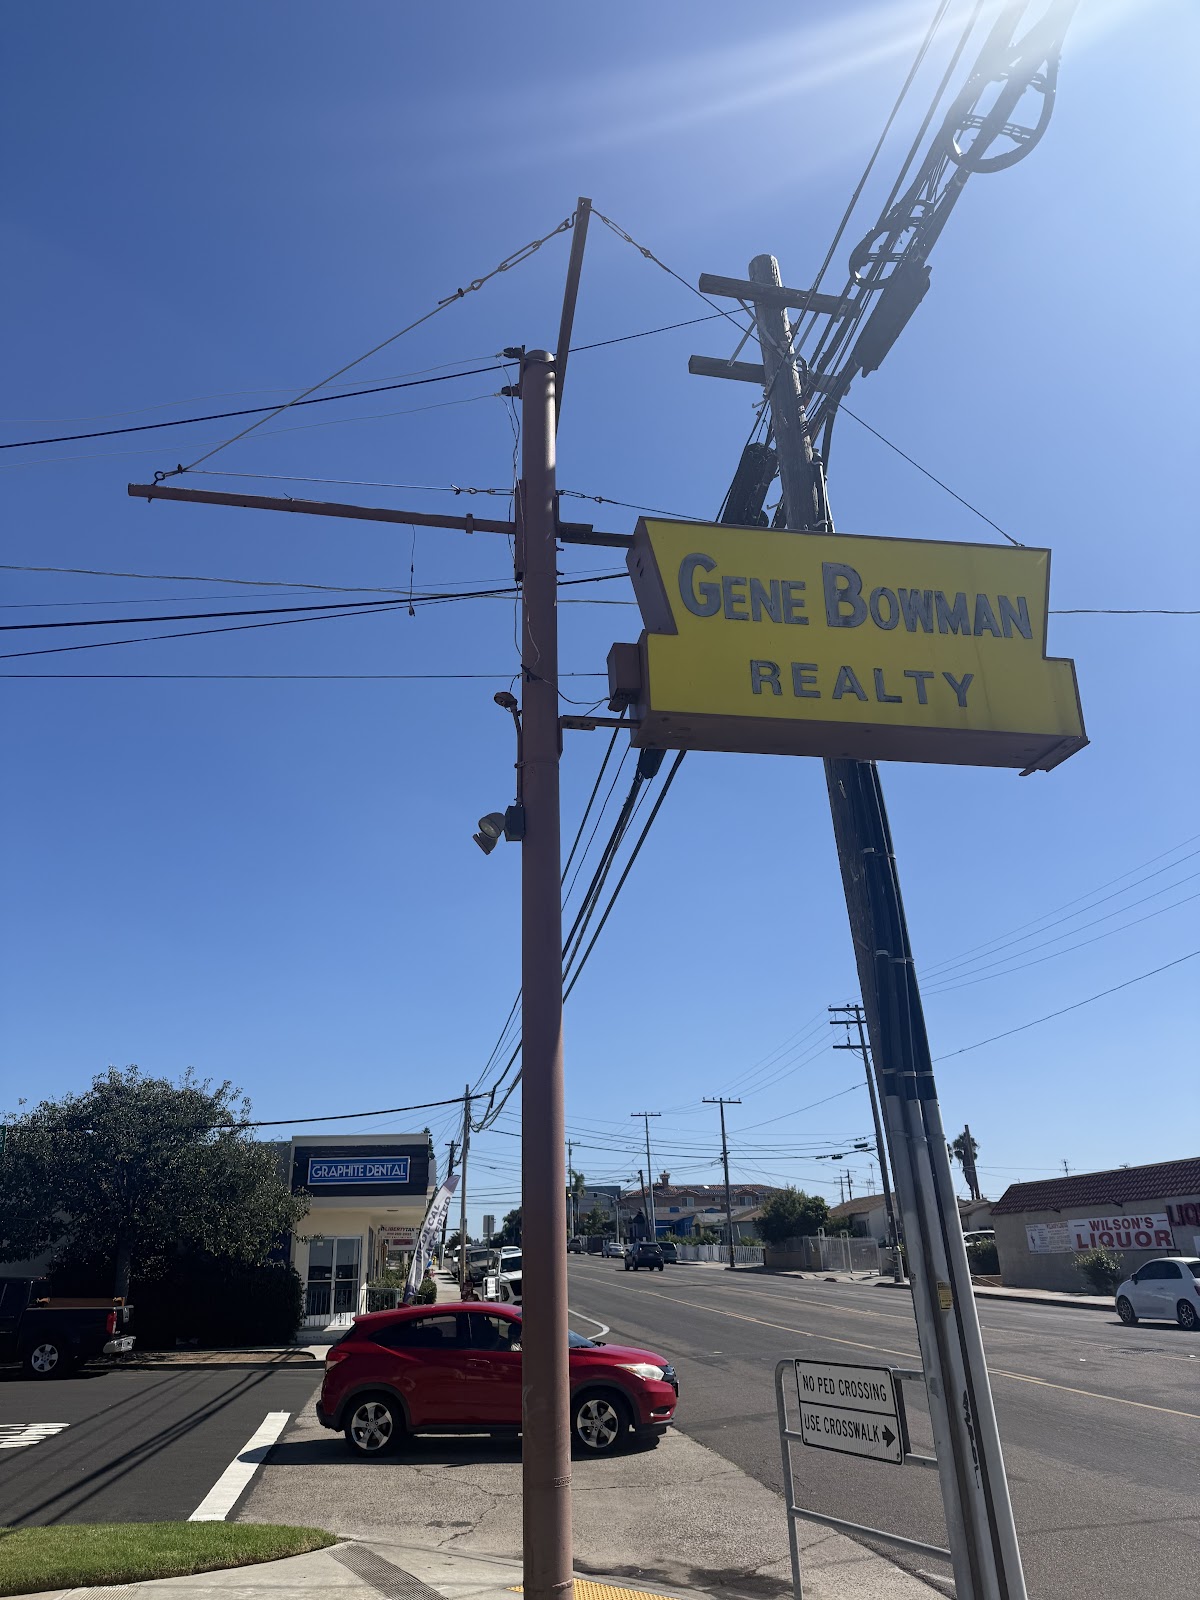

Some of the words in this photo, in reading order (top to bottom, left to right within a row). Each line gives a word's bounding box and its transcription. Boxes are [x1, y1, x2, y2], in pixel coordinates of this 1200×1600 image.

[678, 553, 809, 625] GENE
[821, 561, 1033, 639] BOWMAN
[750, 659, 974, 707] REALTY
[312, 1165, 364, 1178] GRAPHITE
[366, 1164, 405, 1176] DENTAL
[1088, 1217, 1154, 1231] WILSON'S
[1076, 1230, 1172, 1249] LIQUOR
[802, 1375, 815, 1392] NO
[817, 1376, 835, 1395] PED
[838, 1379, 887, 1402] CROSSING
[804, 1413, 822, 1432] USE
[823, 1416, 880, 1443] CROSSWALK
